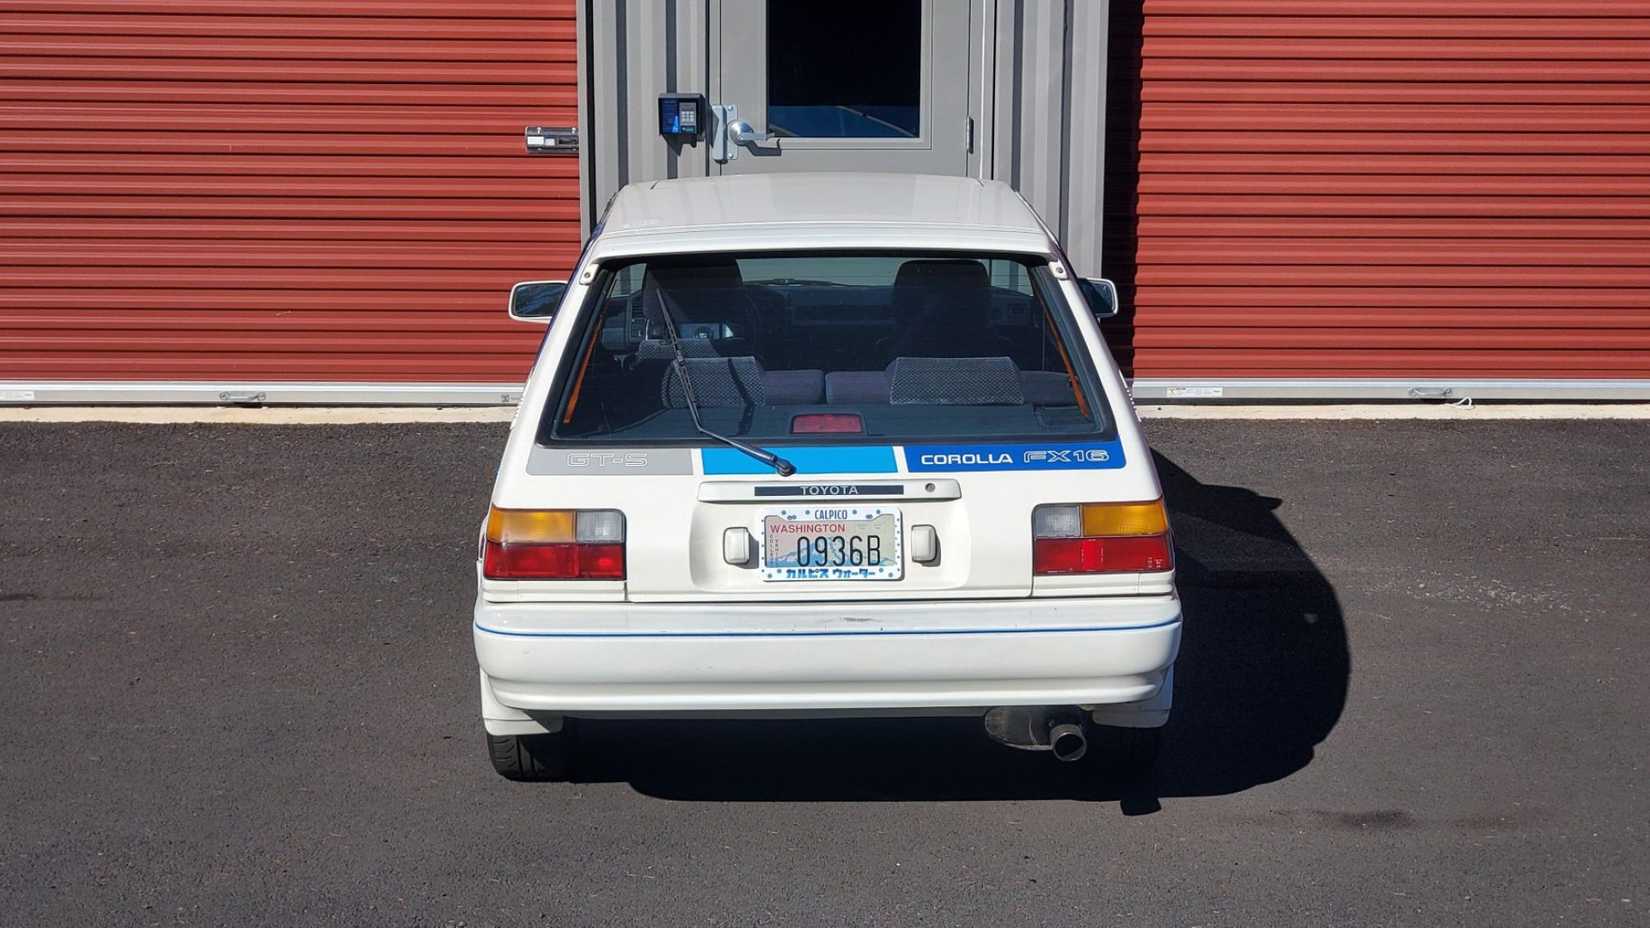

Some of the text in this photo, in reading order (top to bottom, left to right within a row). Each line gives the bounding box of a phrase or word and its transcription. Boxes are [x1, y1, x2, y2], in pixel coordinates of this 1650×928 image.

[921, 449, 1110, 465] COROLLA FX16
[801, 486, 859, 495] TOYOTA
[814, 509, 848, 520] CALPICO
[769, 523, 846, 534] WASHINGTON
[797, 535, 881, 567] 0936B
